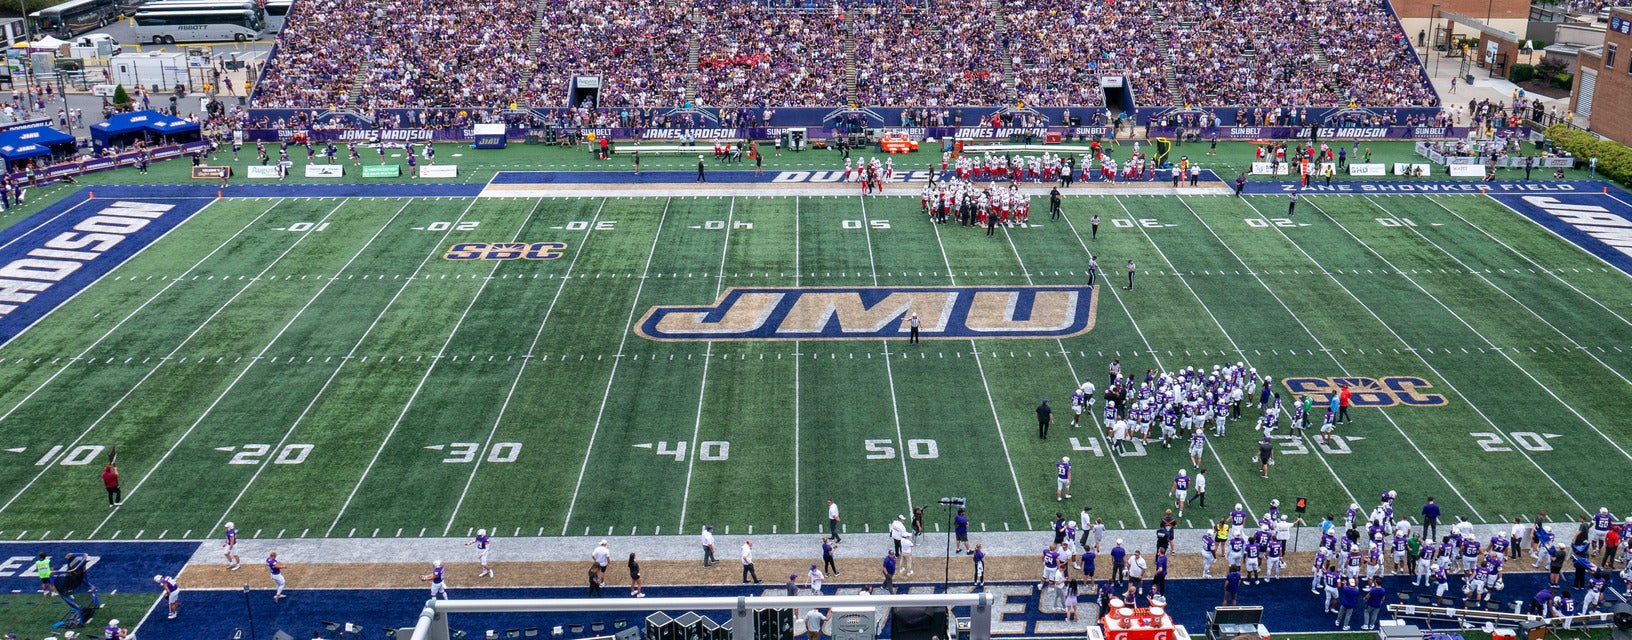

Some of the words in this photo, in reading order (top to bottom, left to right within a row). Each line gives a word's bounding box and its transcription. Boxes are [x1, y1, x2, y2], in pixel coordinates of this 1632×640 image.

[339, 130, 379, 140] JAMES
[381, 130, 433, 140] MADISON
[642, 128, 681, 139] JAMES
[685, 128, 736, 139] MADISON
[910, 127, 926, 135] BELT
[955, 127, 994, 138] JAMES
[1076, 127, 1090, 135] SUN
[1091, 127, 1107, 135] BELT
[1230, 127, 1245, 135] SUN
[1246, 127, 1261, 135] BELT
[1337, 127, 1388, 138] MADISON
[1415, 127, 1429, 135] SUN
[1430, 127, 1446, 135] BELT
[771, 171, 943, 183] DUES
[1360, 183, 1495, 191] SHOWKER
[1499, 183, 1577, 191] FIELD
[287, 222, 331, 232] 10
[427, 221, 480, 231] 20
[566, 221, 618, 231] 30
[704, 220, 753, 230] 40
[842, 219, 891, 230] 50
[1111, 218, 1164, 228] 30
[1244, 217, 1297, 228] 20
[1374, 217, 1418, 228] 10
[443, 242, 567, 260] SBC
[0, 200, 176, 318] ADISON
[642, 287, 1092, 339] JMU
[1282, 376, 1448, 407] SBC
[1069, 436, 1147, 457] 40
[1269, 434, 1352, 455] 30
[1470, 431, 1554, 452] 20
[229, 443, 315, 465] 20
[442, 442, 522, 463] 30
[656, 440, 730, 462] 40
[864, 438, 940, 460] 50
[34, 444, 104, 466] 10
